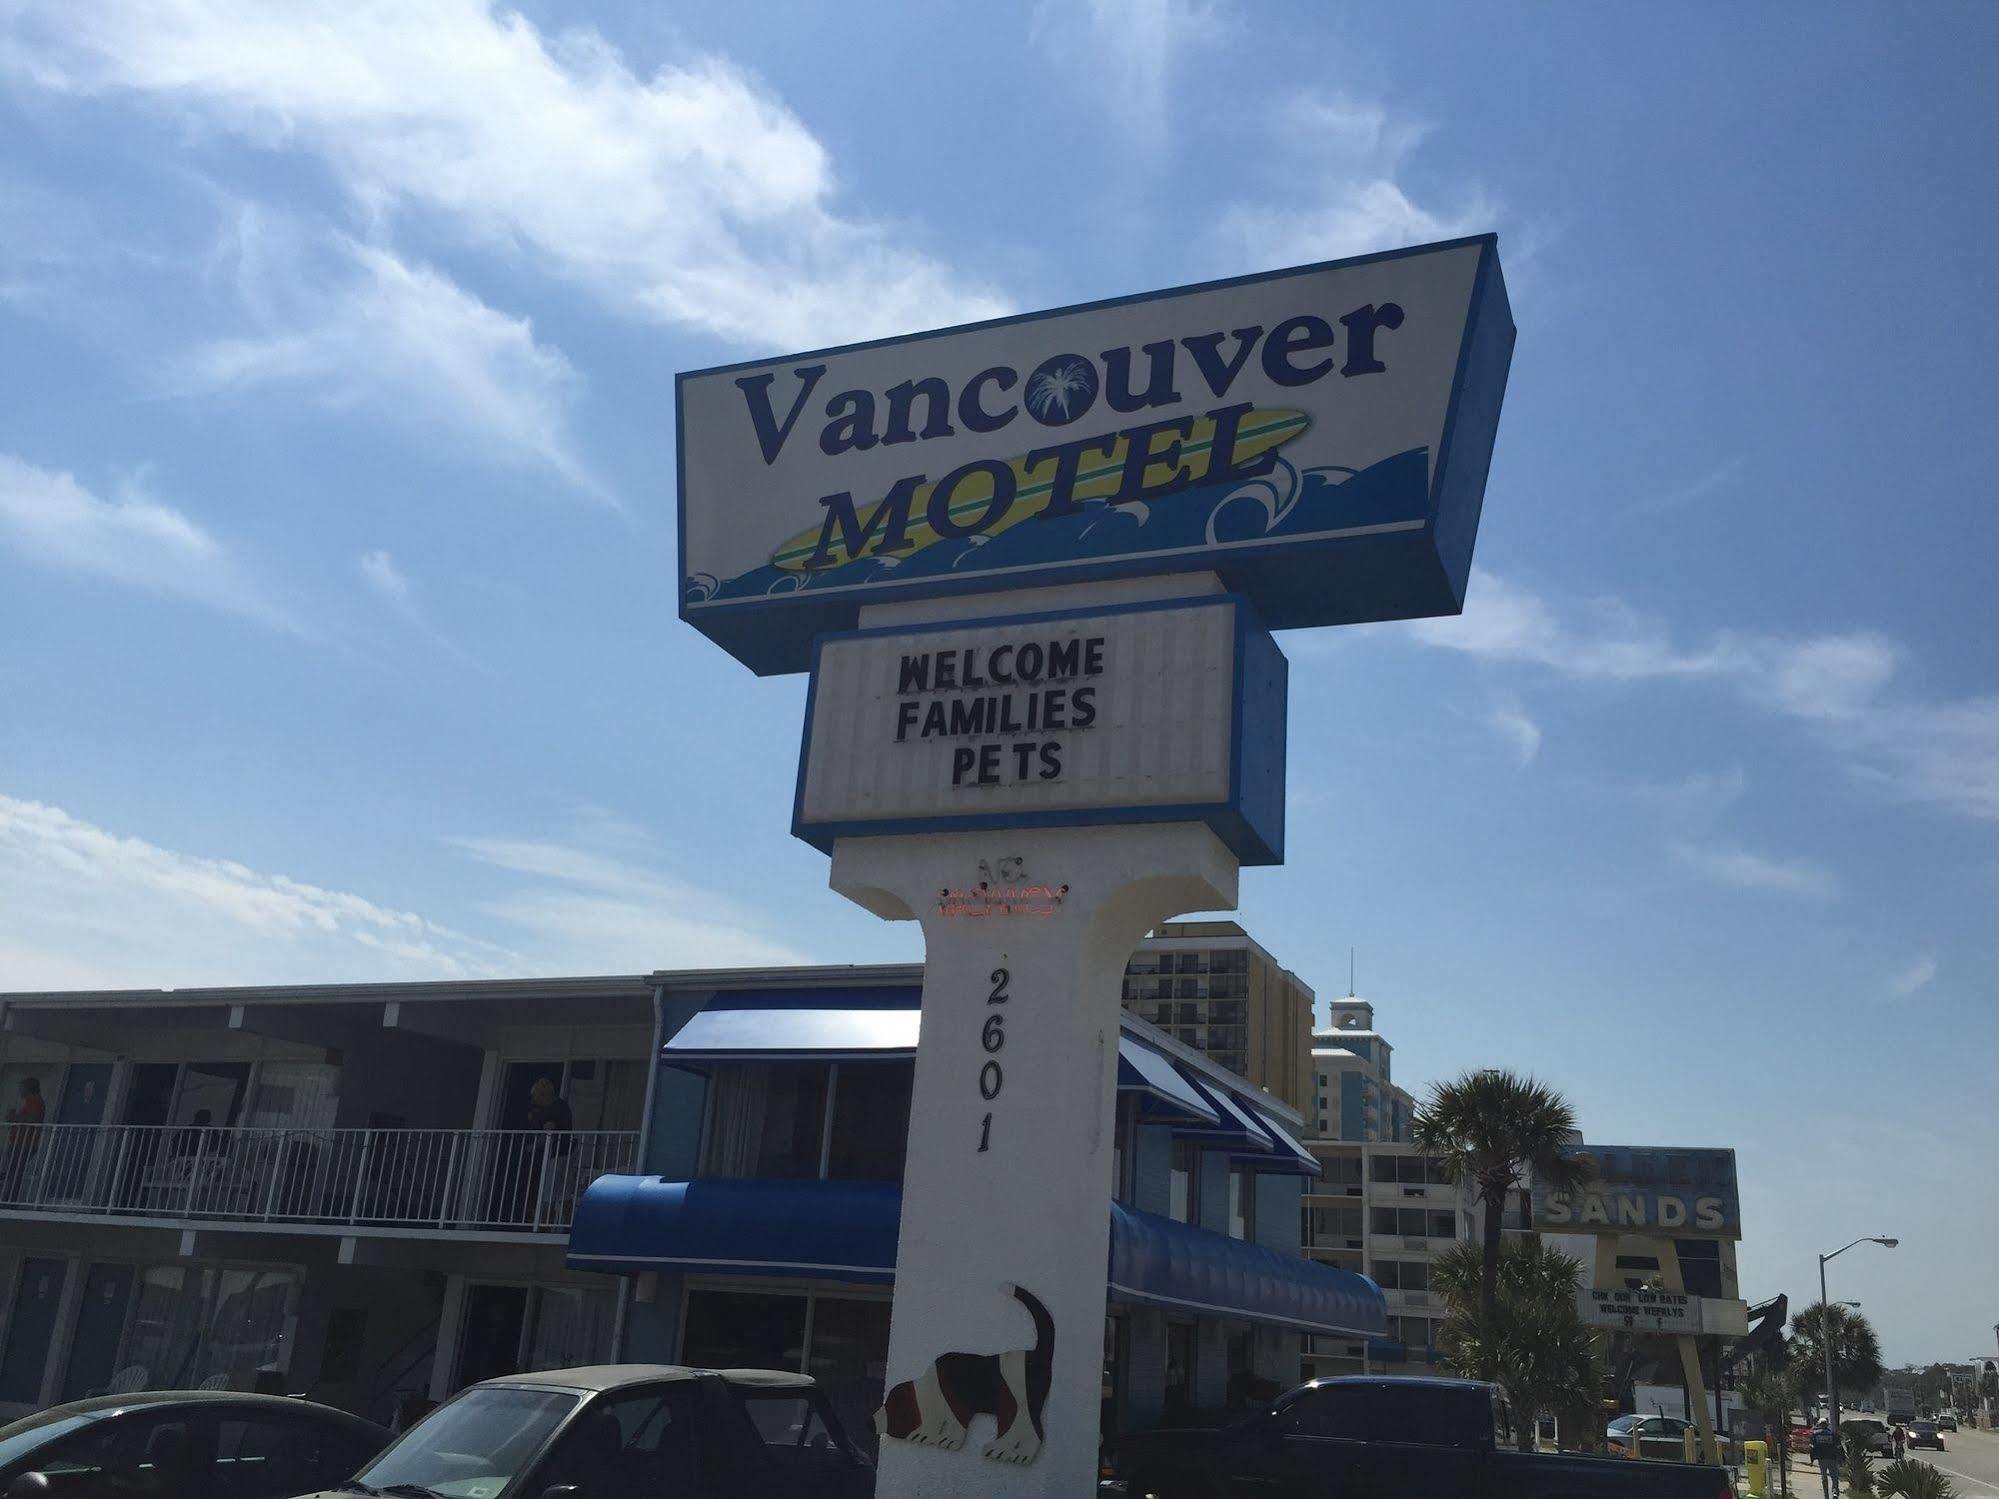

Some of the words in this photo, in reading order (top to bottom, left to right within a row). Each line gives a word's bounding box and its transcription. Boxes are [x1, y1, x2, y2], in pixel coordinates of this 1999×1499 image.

[735, 303, 1405, 466] Vancouver
[805, 402, 1279, 569] MOTEL
[899, 637, 1105, 691] WELCOME
[896, 687, 1096, 740] FAMILIES
[952, 742, 1062, 784] PETS
[976, 967, 1010, 1153] 2601
[1545, 1191, 1725, 1229] SANDS
[1600, 1304, 1639, 1314] WELCOME
[1660, 1295, 1688, 1304] RATES
